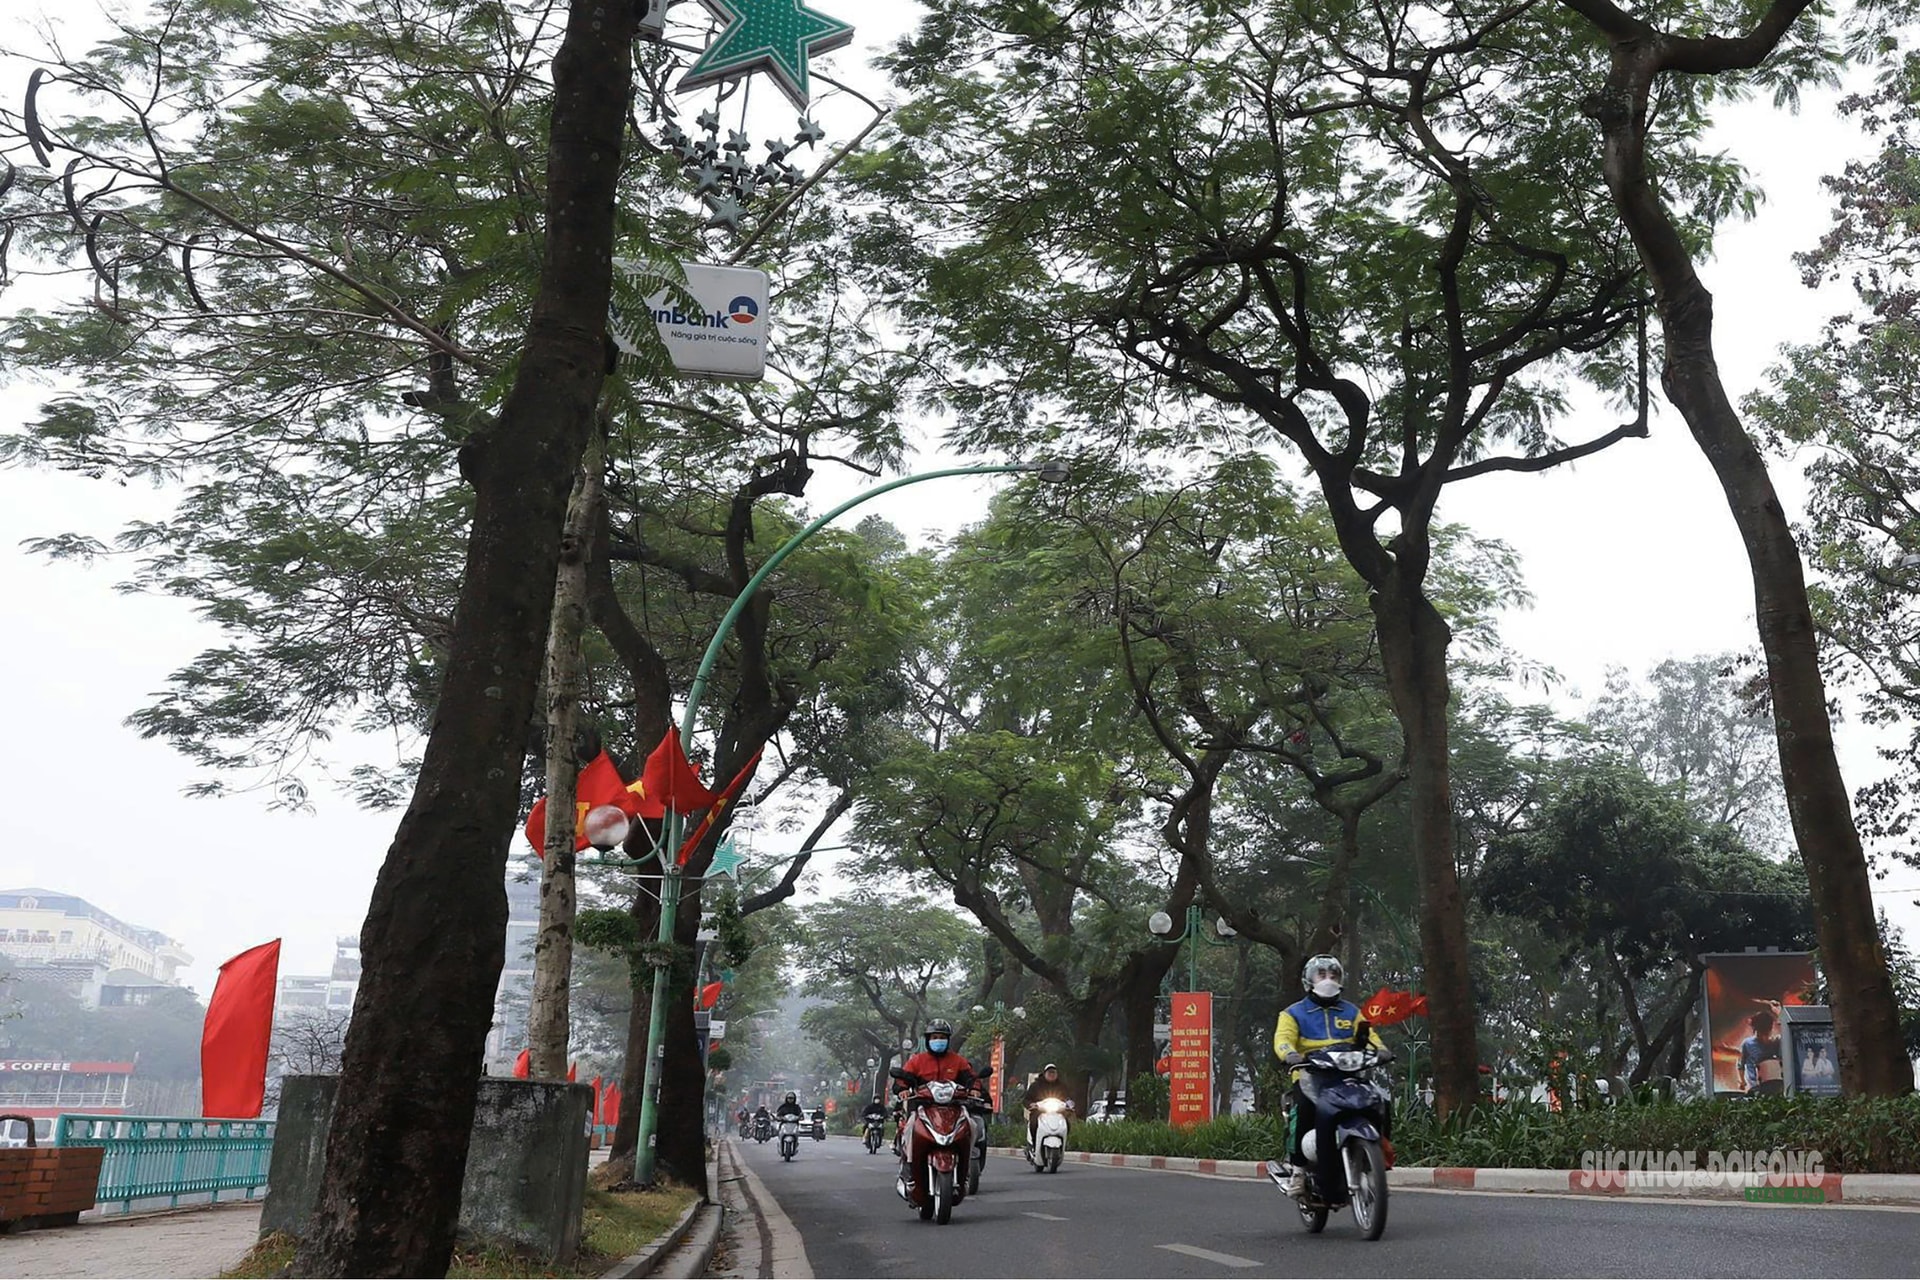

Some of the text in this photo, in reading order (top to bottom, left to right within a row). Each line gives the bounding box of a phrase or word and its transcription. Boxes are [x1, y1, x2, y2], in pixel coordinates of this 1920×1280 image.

[718, 335, 737, 343] cuộc
[738, 336, 757, 346] sống
[1334, 1016, 1351, 1029] be
[11, 1062, 71, 1071] COFFEE
